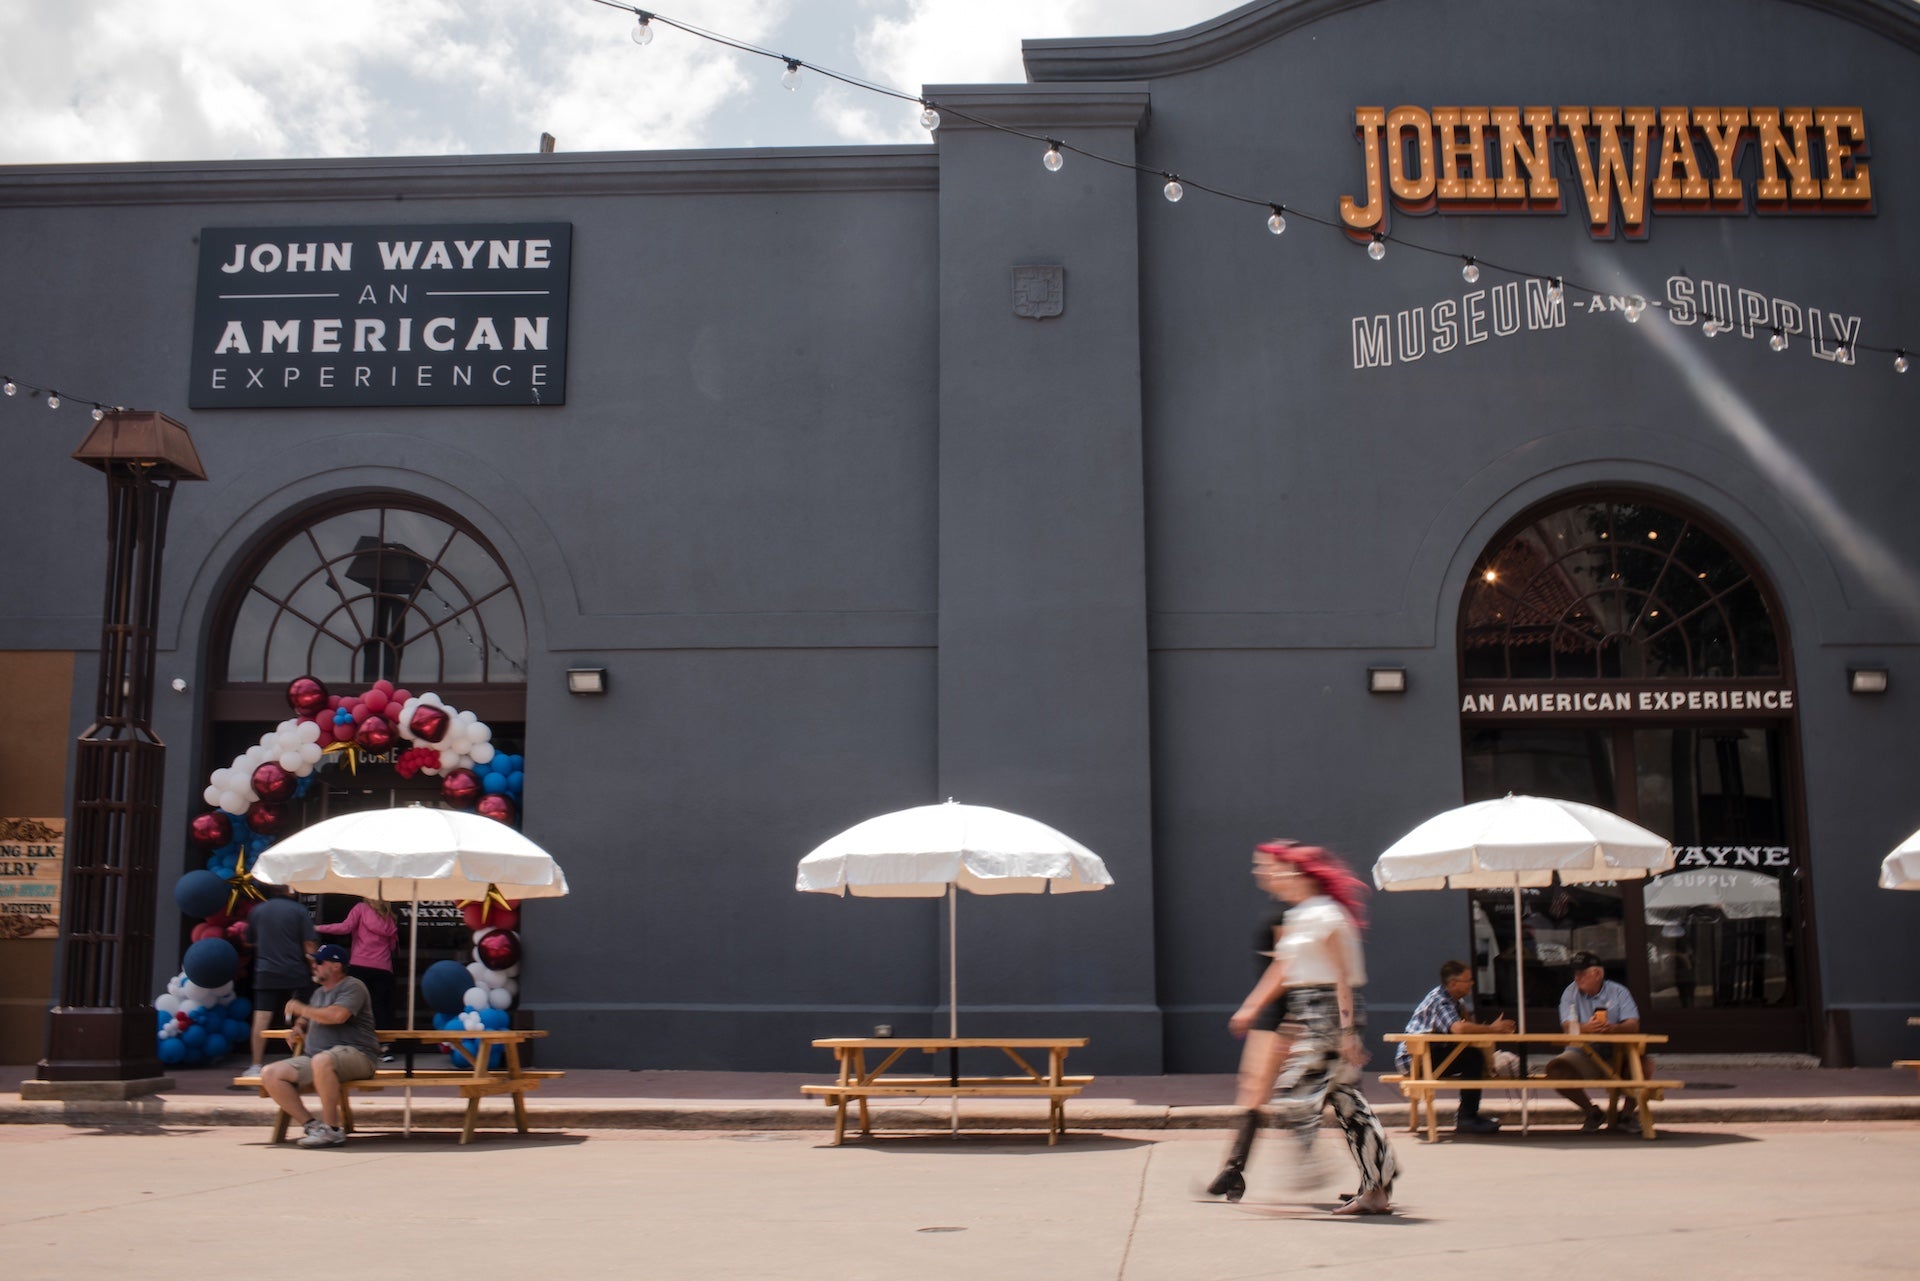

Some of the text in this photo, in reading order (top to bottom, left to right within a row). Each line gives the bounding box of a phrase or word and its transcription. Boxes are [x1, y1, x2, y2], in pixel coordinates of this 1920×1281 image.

[1339, 104, 1872, 230] JOHN WAYNE
[221, 239, 552, 275] JOHN WAYNE
[358, 284, 409, 304] AN
[1351, 276, 1567, 370] MUSEUM
[1666, 275, 1862, 366] SUPPLY
[214, 316, 549, 355] AMERICAN
[212, 364, 547, 389] EXPERIENCE
[1462, 689, 1793, 712] AN AMERICAN EXPERIENCE
[27, 845, 57, 857] ELK
[1673, 874, 1738, 889] SUPPLY
